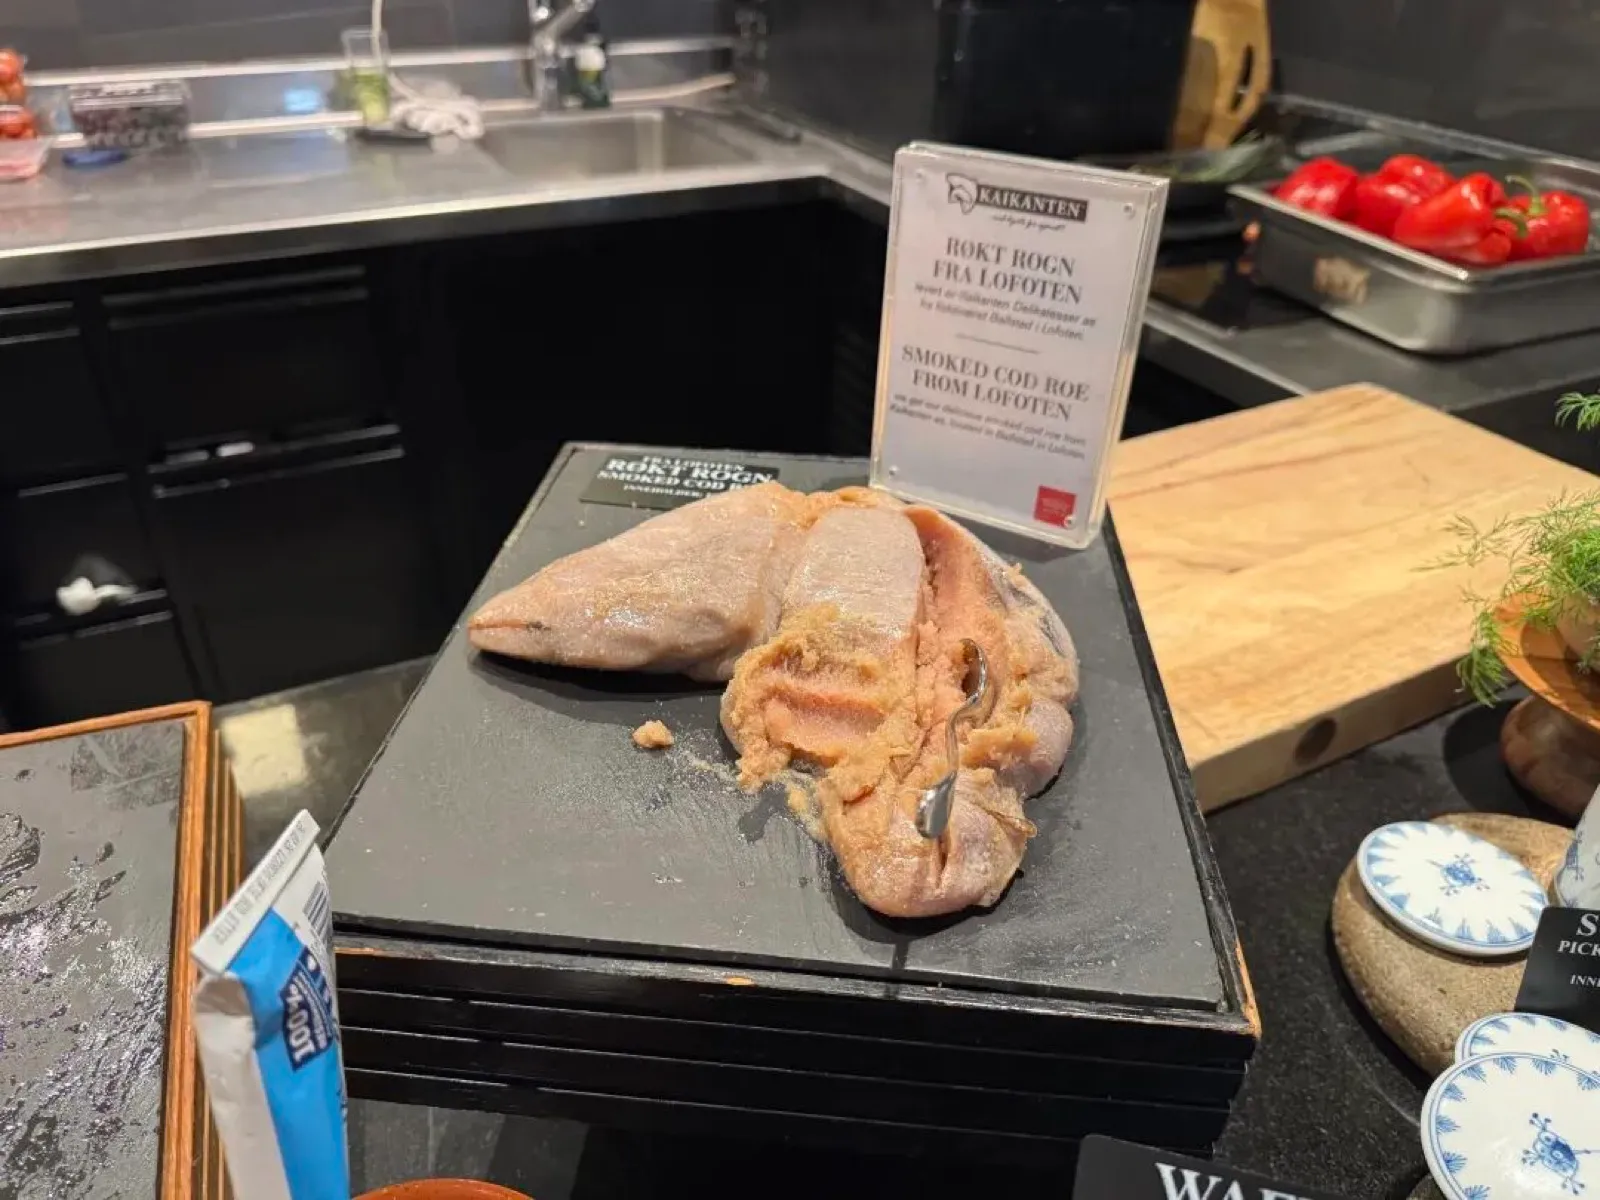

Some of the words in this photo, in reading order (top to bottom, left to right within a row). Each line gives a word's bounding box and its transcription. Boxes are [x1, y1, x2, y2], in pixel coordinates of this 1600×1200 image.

[980, 186, 1081, 217] KAIKANTEN
[1012, 249, 1076, 277] ROGN
[933, 260, 971, 285] FRA
[979, 267, 1083, 304] LOFOTEN
[901, 344, 989, 379] SMOKED
[994, 365, 1039, 391] COD
[1043, 376, 1091, 402] ROE
[912, 369, 969, 397] FROM
[973, 383, 1073, 422] LOFOTEN
[596, 469, 680, 486] SMOKED
[683, 479, 726, 491] COD
[691, 466, 772, 484] ROGN
